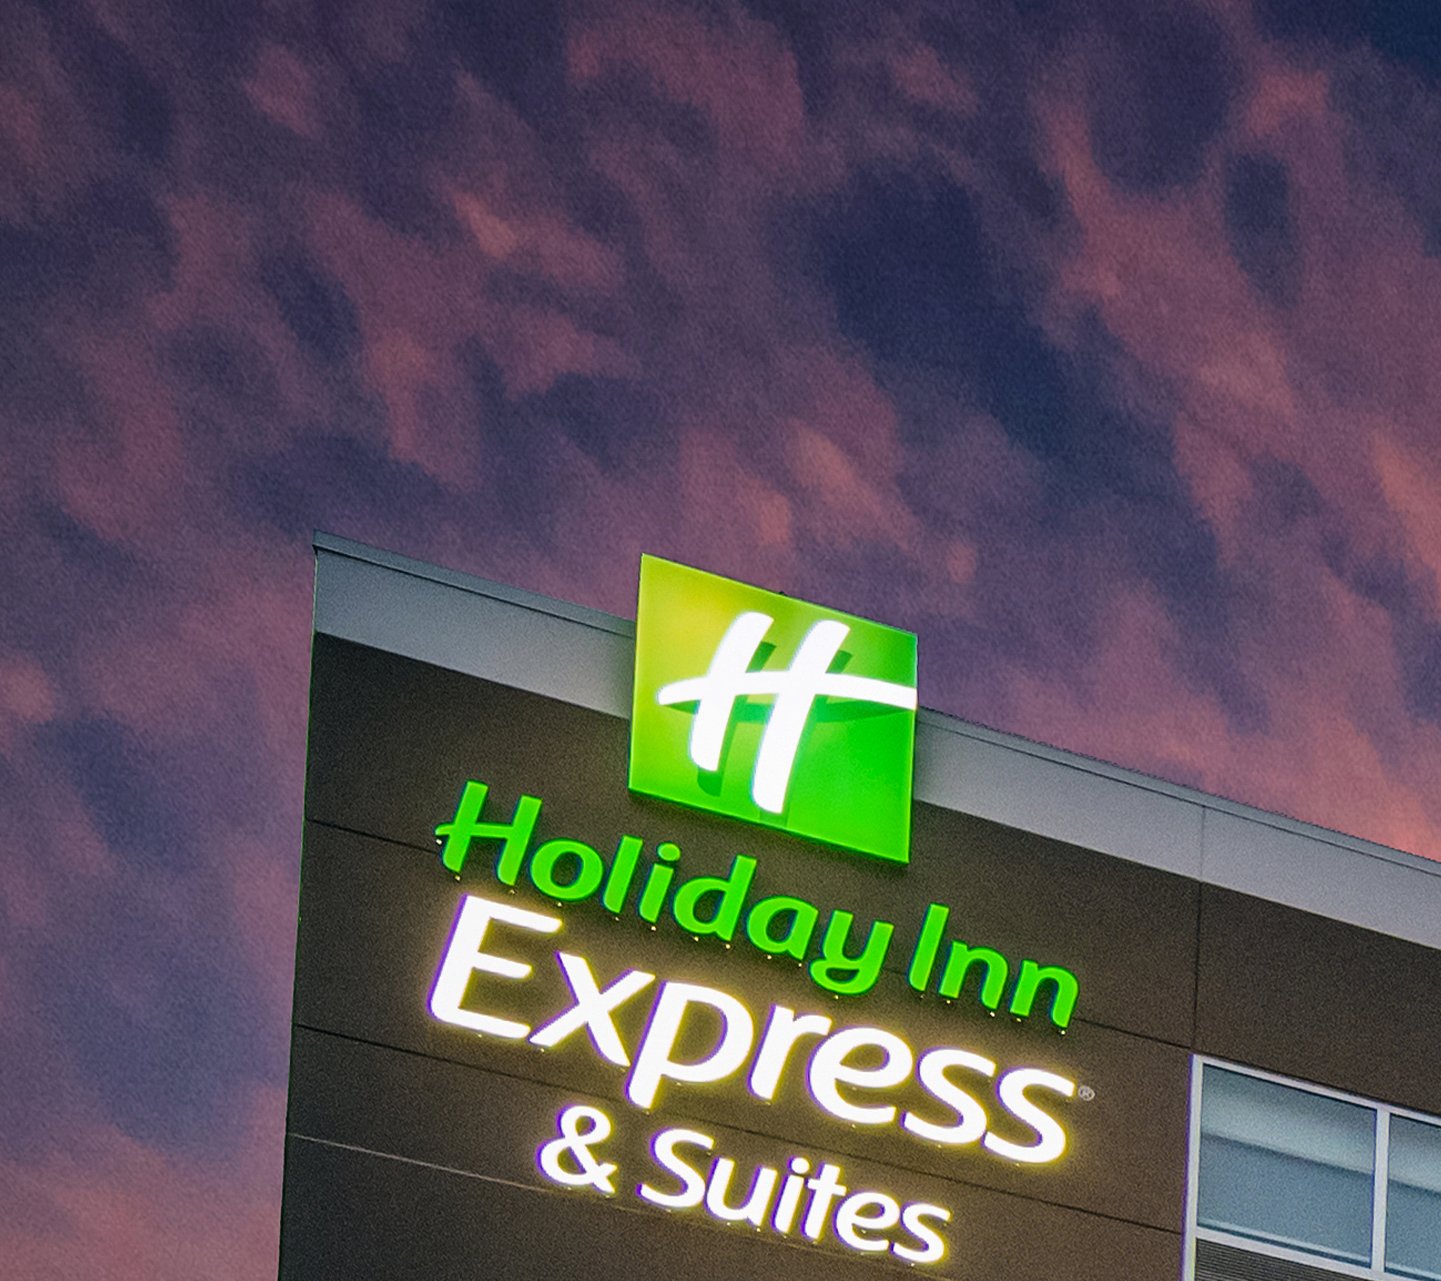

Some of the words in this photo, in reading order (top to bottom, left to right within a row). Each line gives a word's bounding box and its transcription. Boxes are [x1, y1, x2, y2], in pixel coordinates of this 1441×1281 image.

[434, 780, 894, 997] Holiday
[908, 903, 1081, 1029] Inn
[428, 893, 1078, 1166] Express
[538, 1104, 616, 1195] &
[639, 1127, 952, 1265] Suites
